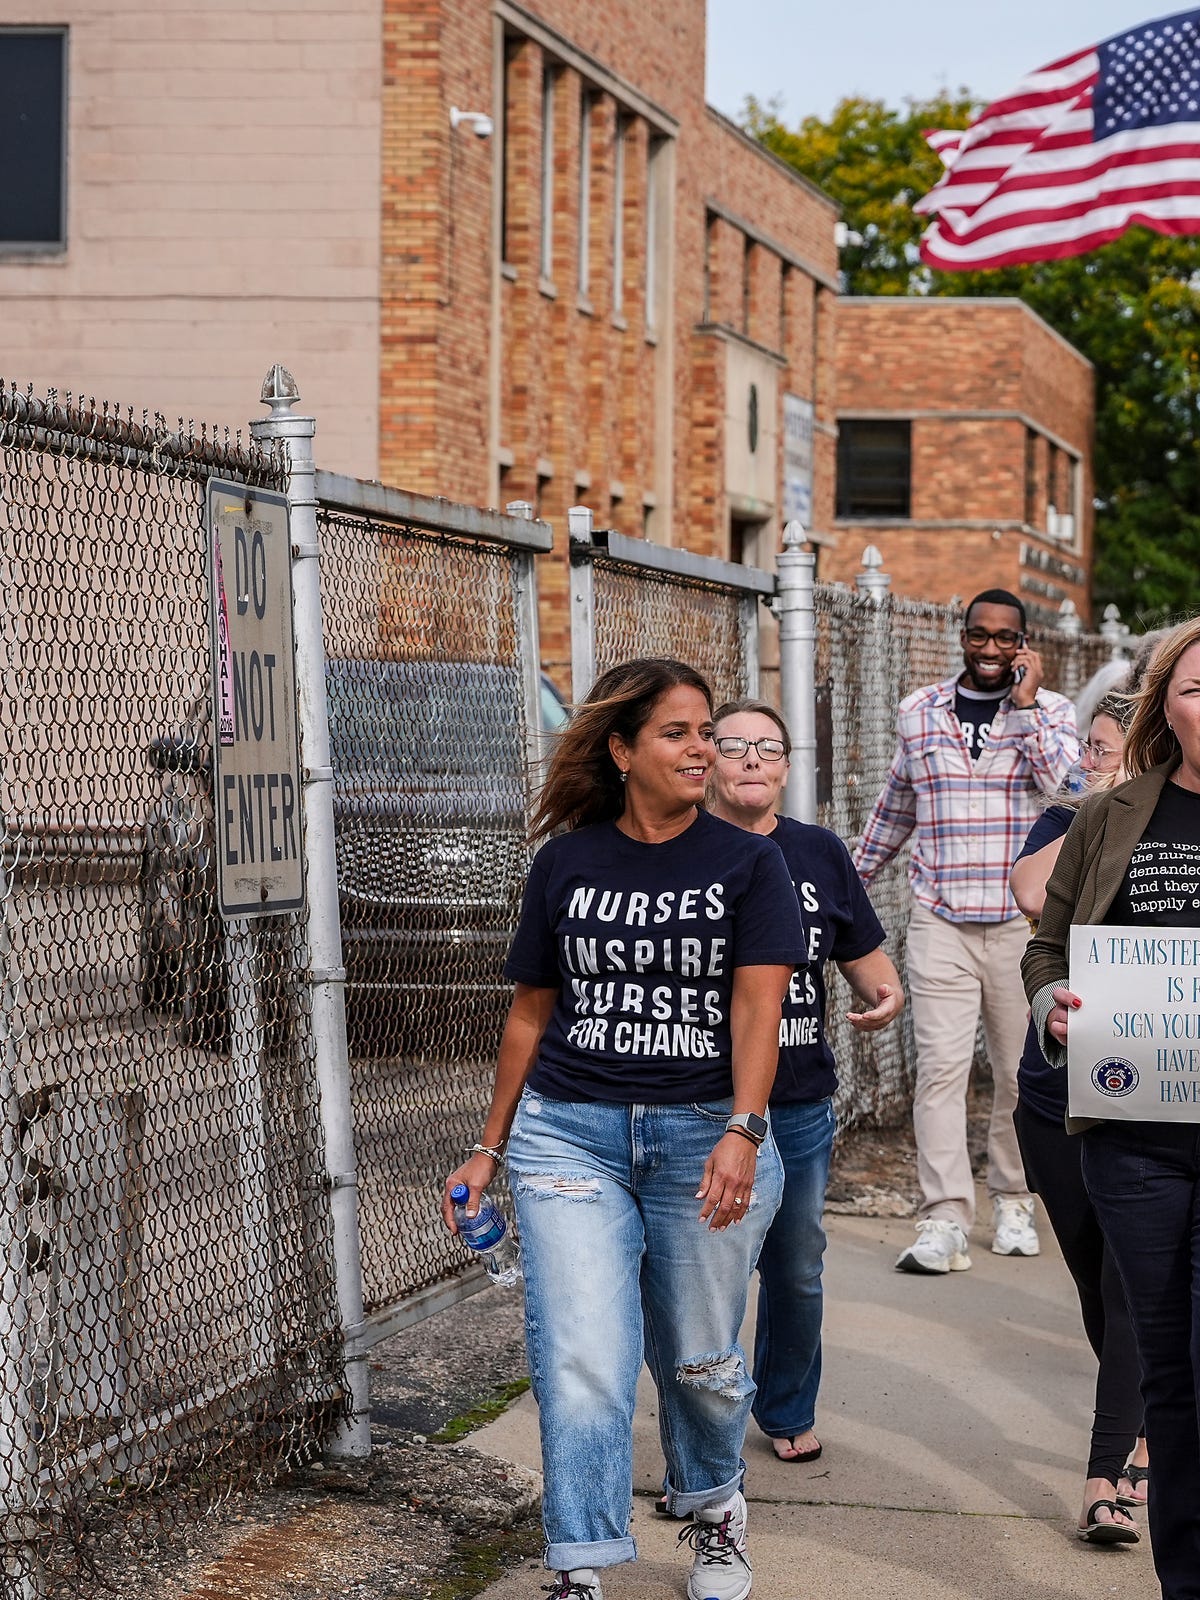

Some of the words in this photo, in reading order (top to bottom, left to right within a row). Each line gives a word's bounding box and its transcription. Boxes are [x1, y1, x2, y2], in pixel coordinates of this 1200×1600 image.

[235, 526, 266, 620] DO
[233, 650, 275, 742] NOT
[224, 774, 297, 865] ENTER
[1131, 852, 1153, 864] the
[1129, 881, 1159, 896] And
[1164, 880, 1199, 893] they
[568, 883, 725, 926] NURSES
[1131, 898, 1186, 913] happily
[564, 936, 726, 977] INSPIRE
[1088, 939, 1099, 964] A
[571, 978, 722, 1027] NURSES
[1167, 977, 1184, 1003] IS
[567, 1018, 606, 1051] FOR
[614, 1020, 720, 1058] CHANGE
[779, 1018, 818, 1047] ANGE
[1113, 1013, 1154, 1038] SIGN
[1157, 1049, 1200, 1072] HAVE
